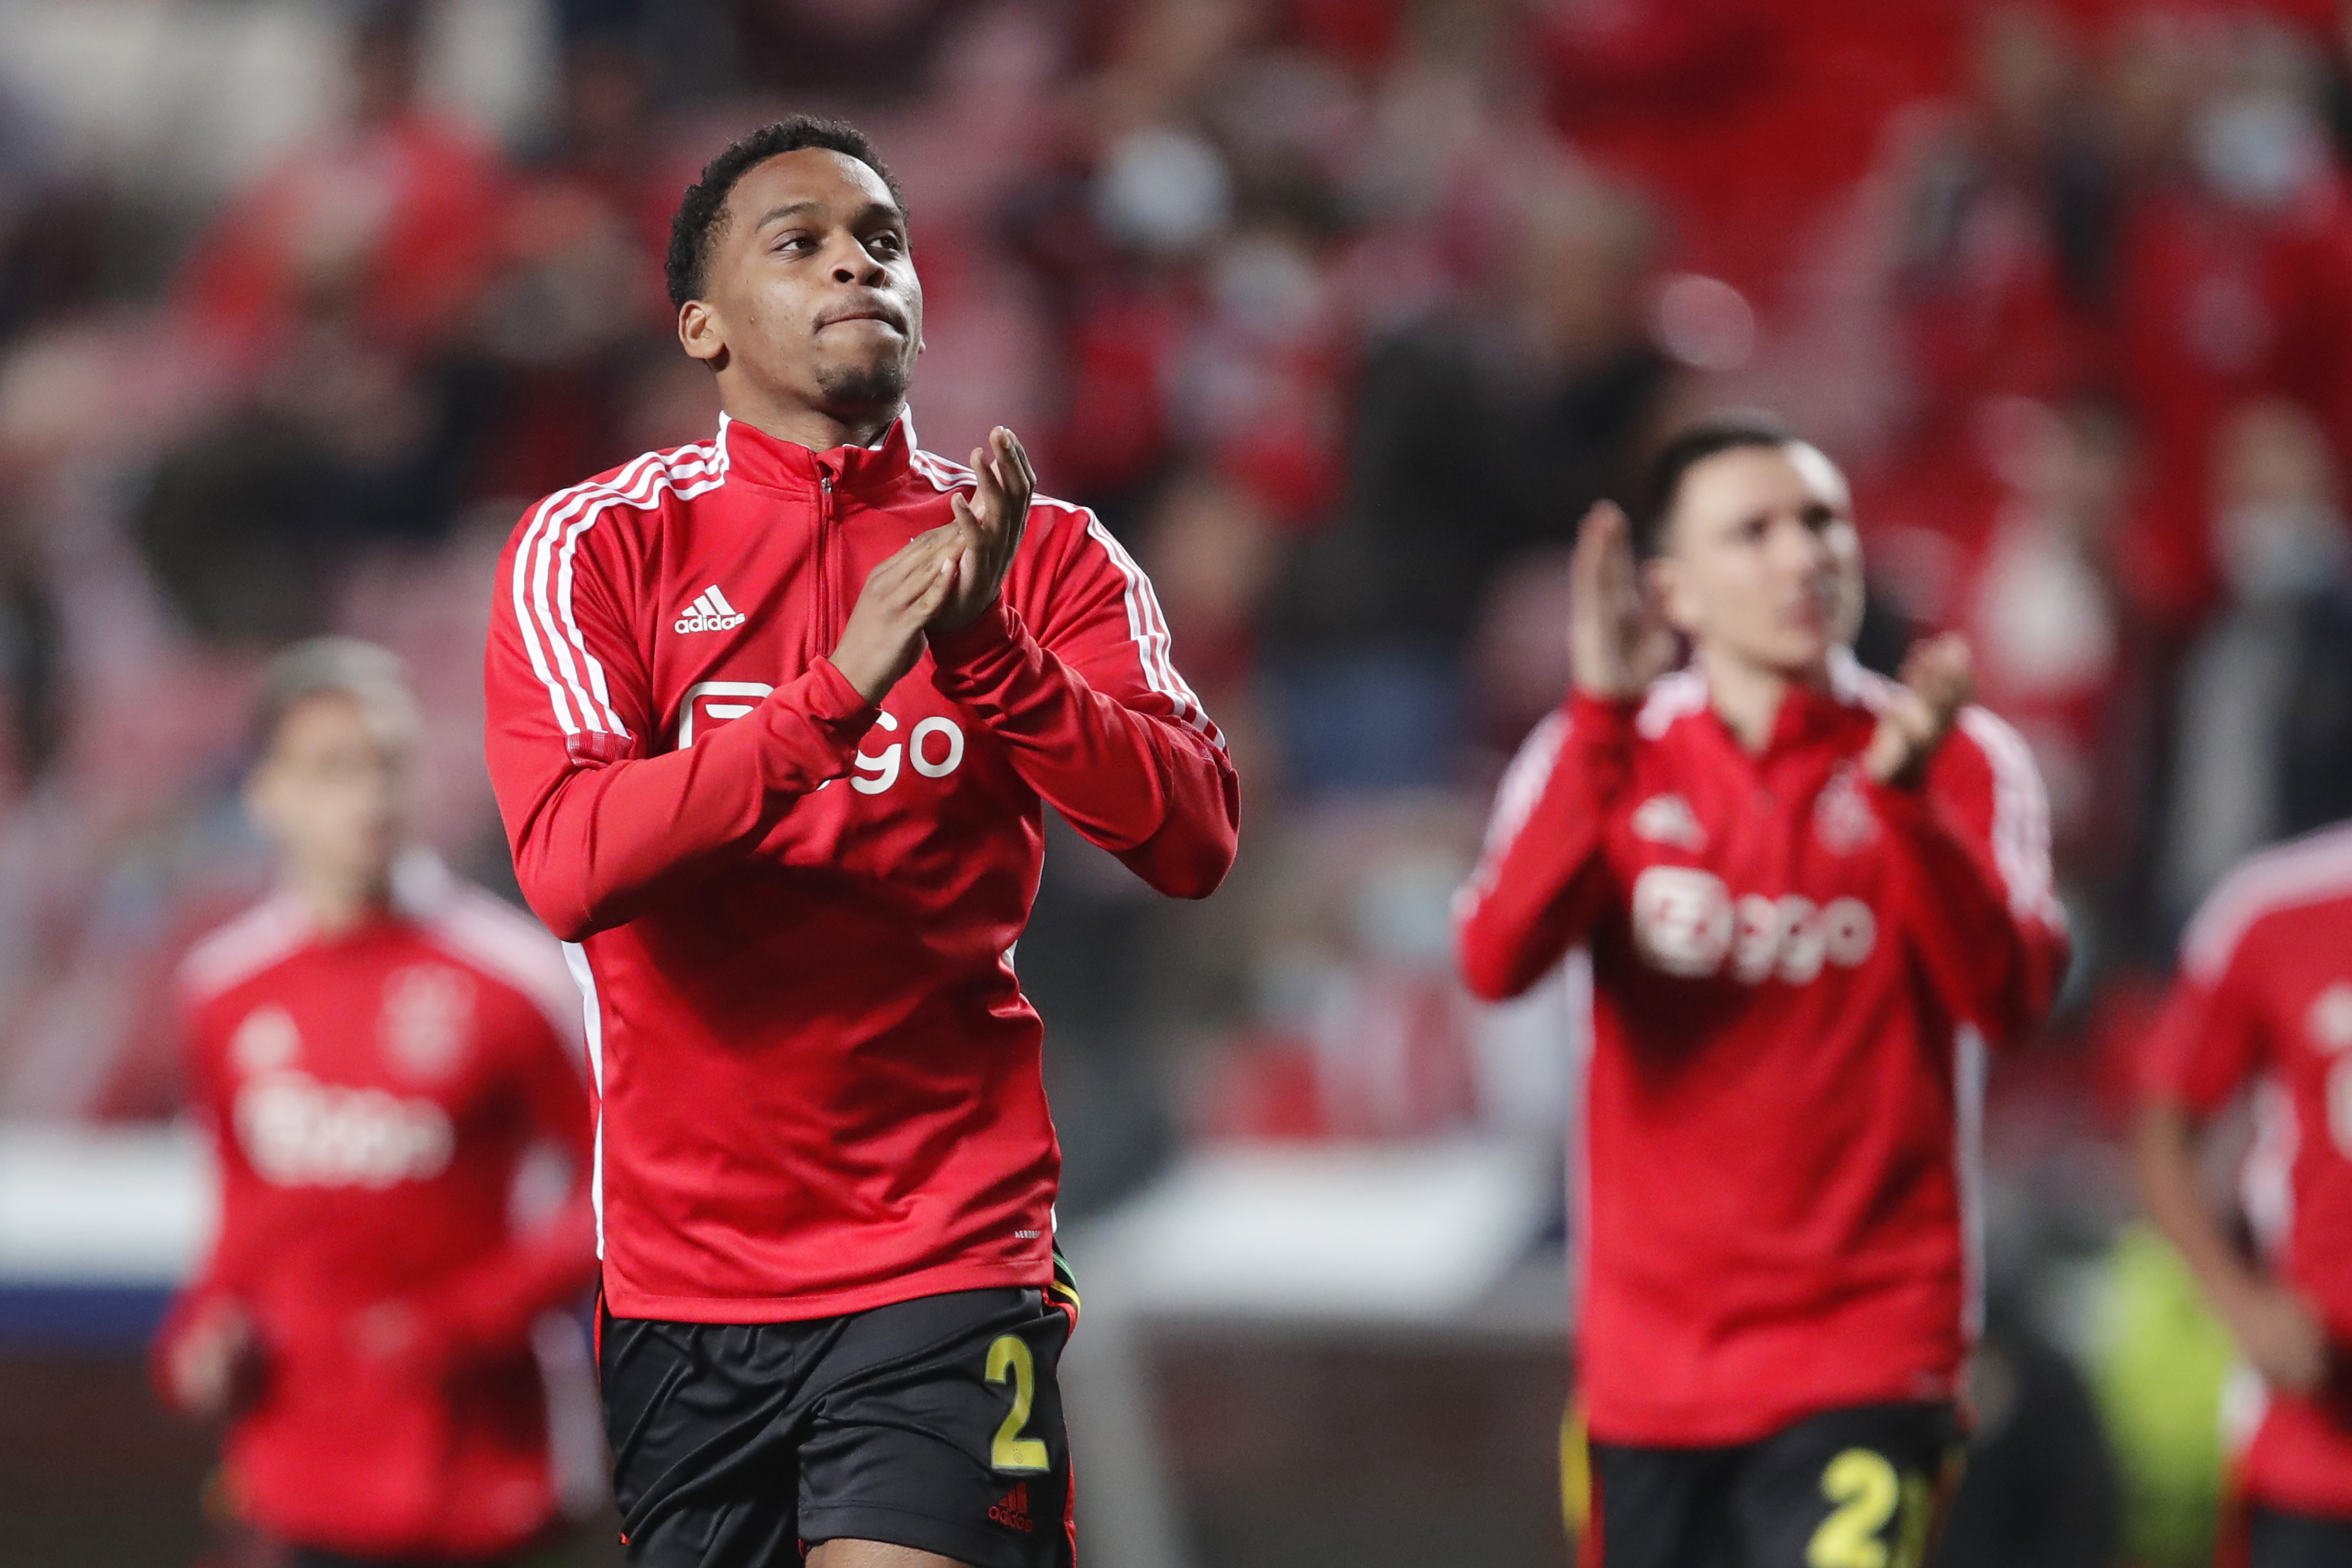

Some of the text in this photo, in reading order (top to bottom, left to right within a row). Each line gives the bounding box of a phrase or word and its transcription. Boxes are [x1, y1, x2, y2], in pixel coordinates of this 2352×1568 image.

[674, 613, 746, 634] adidas
[985, 1334, 1050, 1471] 2
[988, 1506, 1033, 1533] adidas
